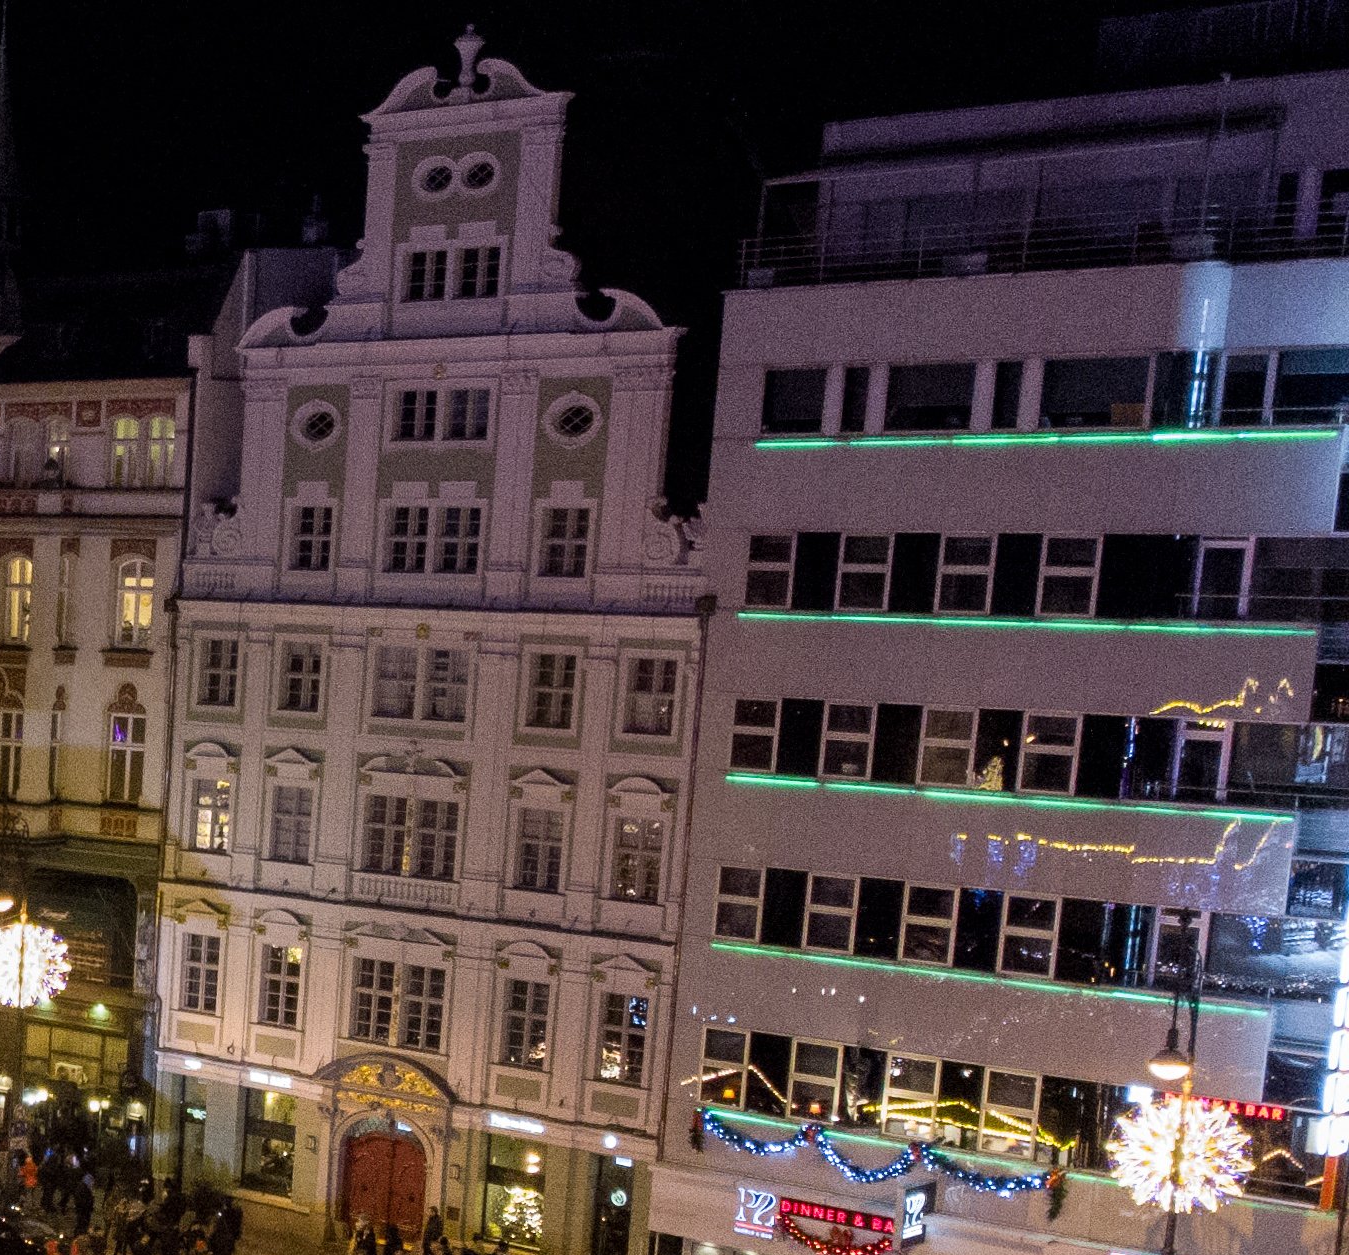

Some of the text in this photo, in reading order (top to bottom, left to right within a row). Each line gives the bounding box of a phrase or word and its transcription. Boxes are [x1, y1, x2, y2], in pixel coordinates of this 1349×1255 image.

[1245, 1104, 1283, 1121] BAR
[781, 1200, 848, 1224] DINNER
[853, 1214, 866, 1228] &
[872, 1217, 895, 1233] BA
